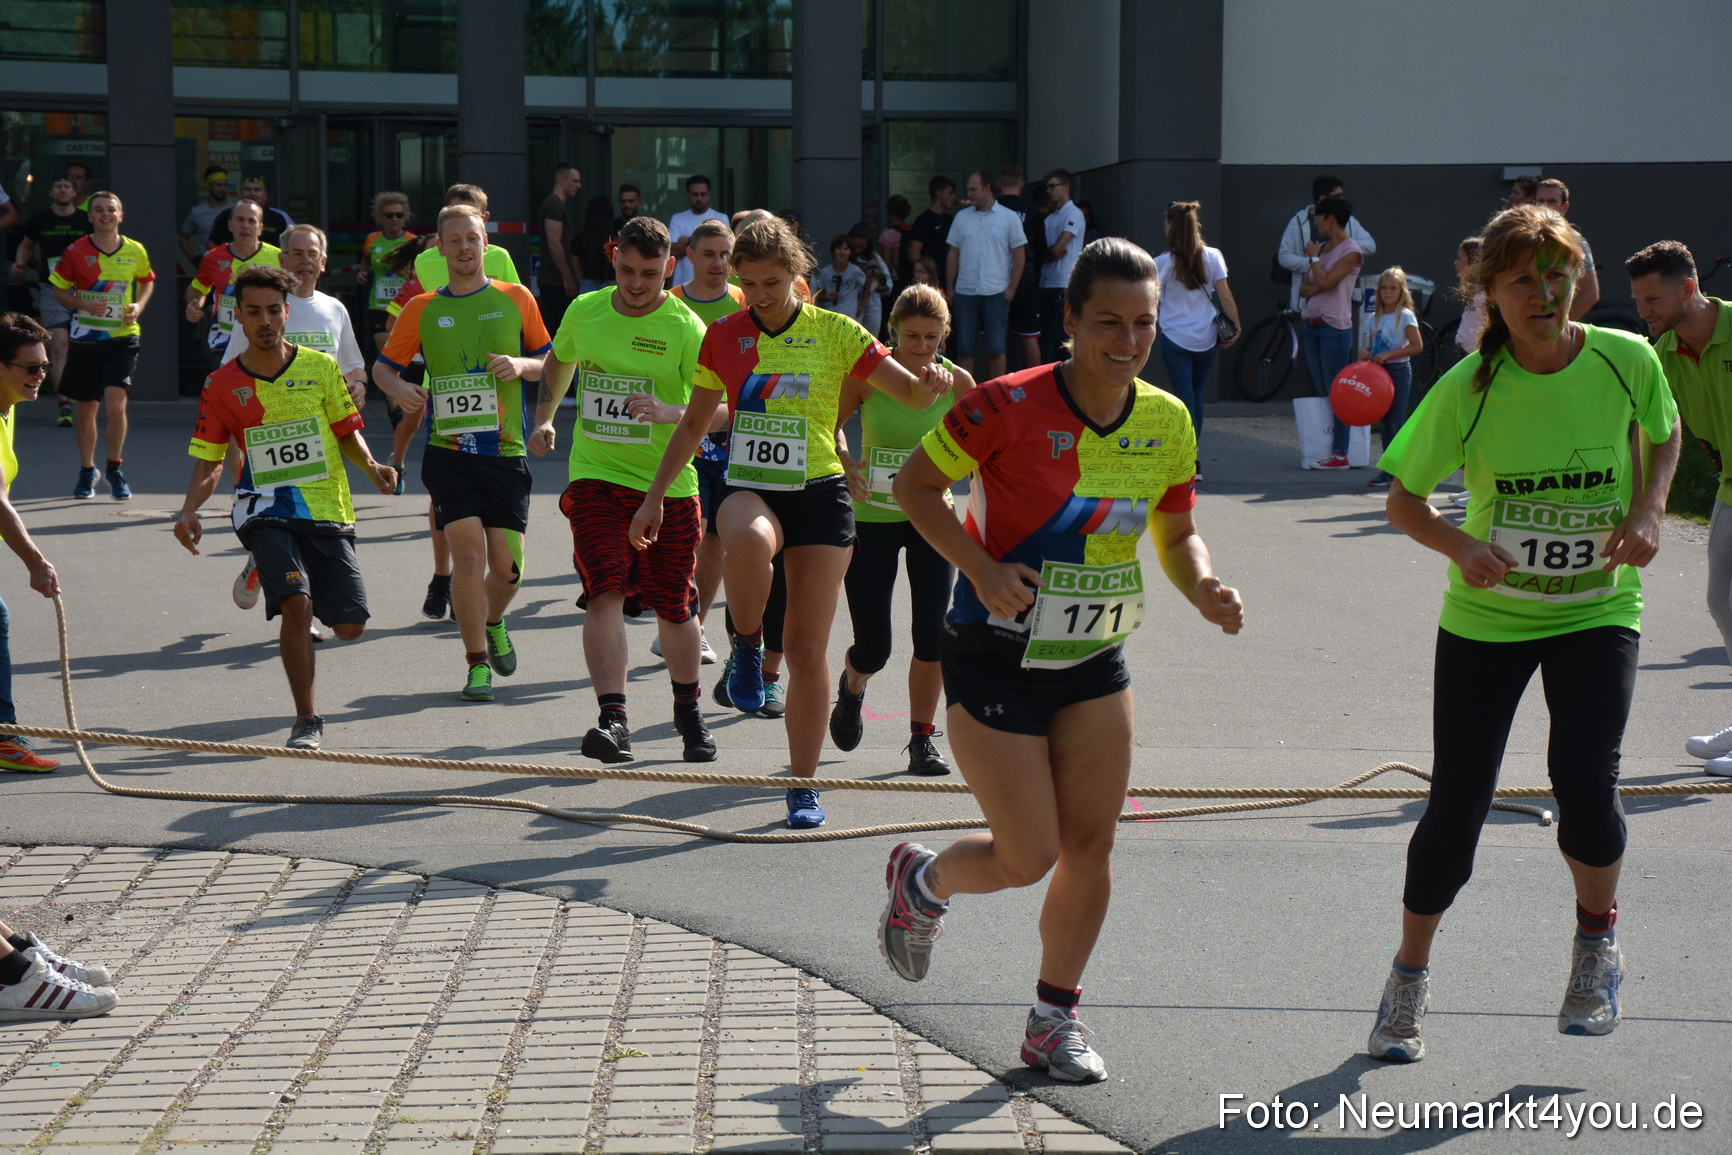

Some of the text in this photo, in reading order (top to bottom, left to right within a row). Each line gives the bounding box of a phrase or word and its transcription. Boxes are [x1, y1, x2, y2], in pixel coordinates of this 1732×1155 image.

[436, 376, 490, 393] BOCK
[586, 375, 645, 393] BOCK
[446, 394, 483, 414] 192
[593, 397, 634, 420] 144
[251, 421, 315, 444] BOCK
[595, 423, 630, 435] CHRIS
[739, 415, 800, 436] BOCK
[265, 442, 310, 466] 168
[745, 439, 790, 465] 180
[876, 451, 907, 466] BO
[737, 466, 763, 480] RONJA
[1495, 467, 1616, 496] BRANDL
[1504, 502, 1611, 530] BOCK
[1520, 538, 1595, 570] 183
[1053, 569, 1138, 592] BOCK
[1063, 602, 1124, 634] 171
[1038, 644, 1077, 656] ERIKA
